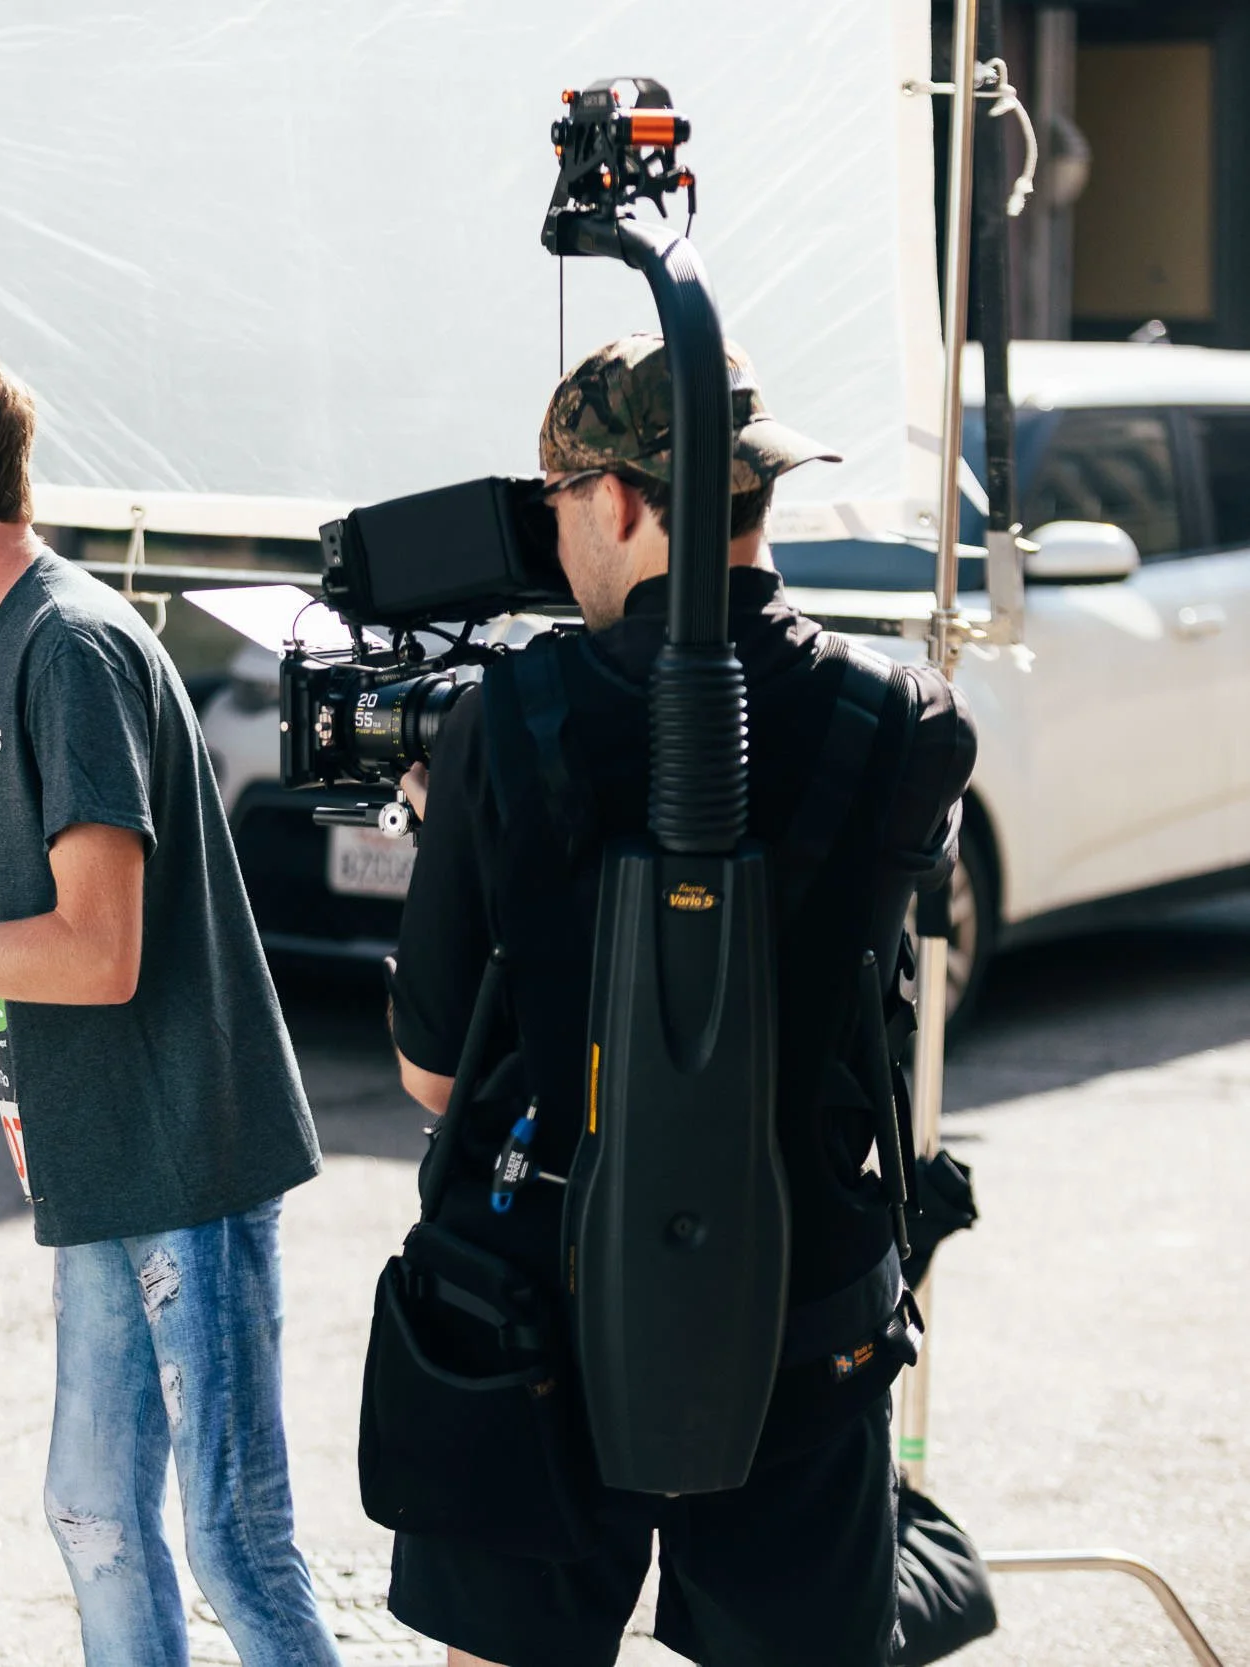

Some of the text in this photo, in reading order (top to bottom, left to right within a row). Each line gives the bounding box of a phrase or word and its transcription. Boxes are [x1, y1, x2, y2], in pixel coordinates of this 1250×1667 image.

[357, 693, 378, 707] 20
[355, 711, 373, 727] 55
[670, 893, 715, 909] Vario 5
[510, 1152, 525, 1182] TOOLS
